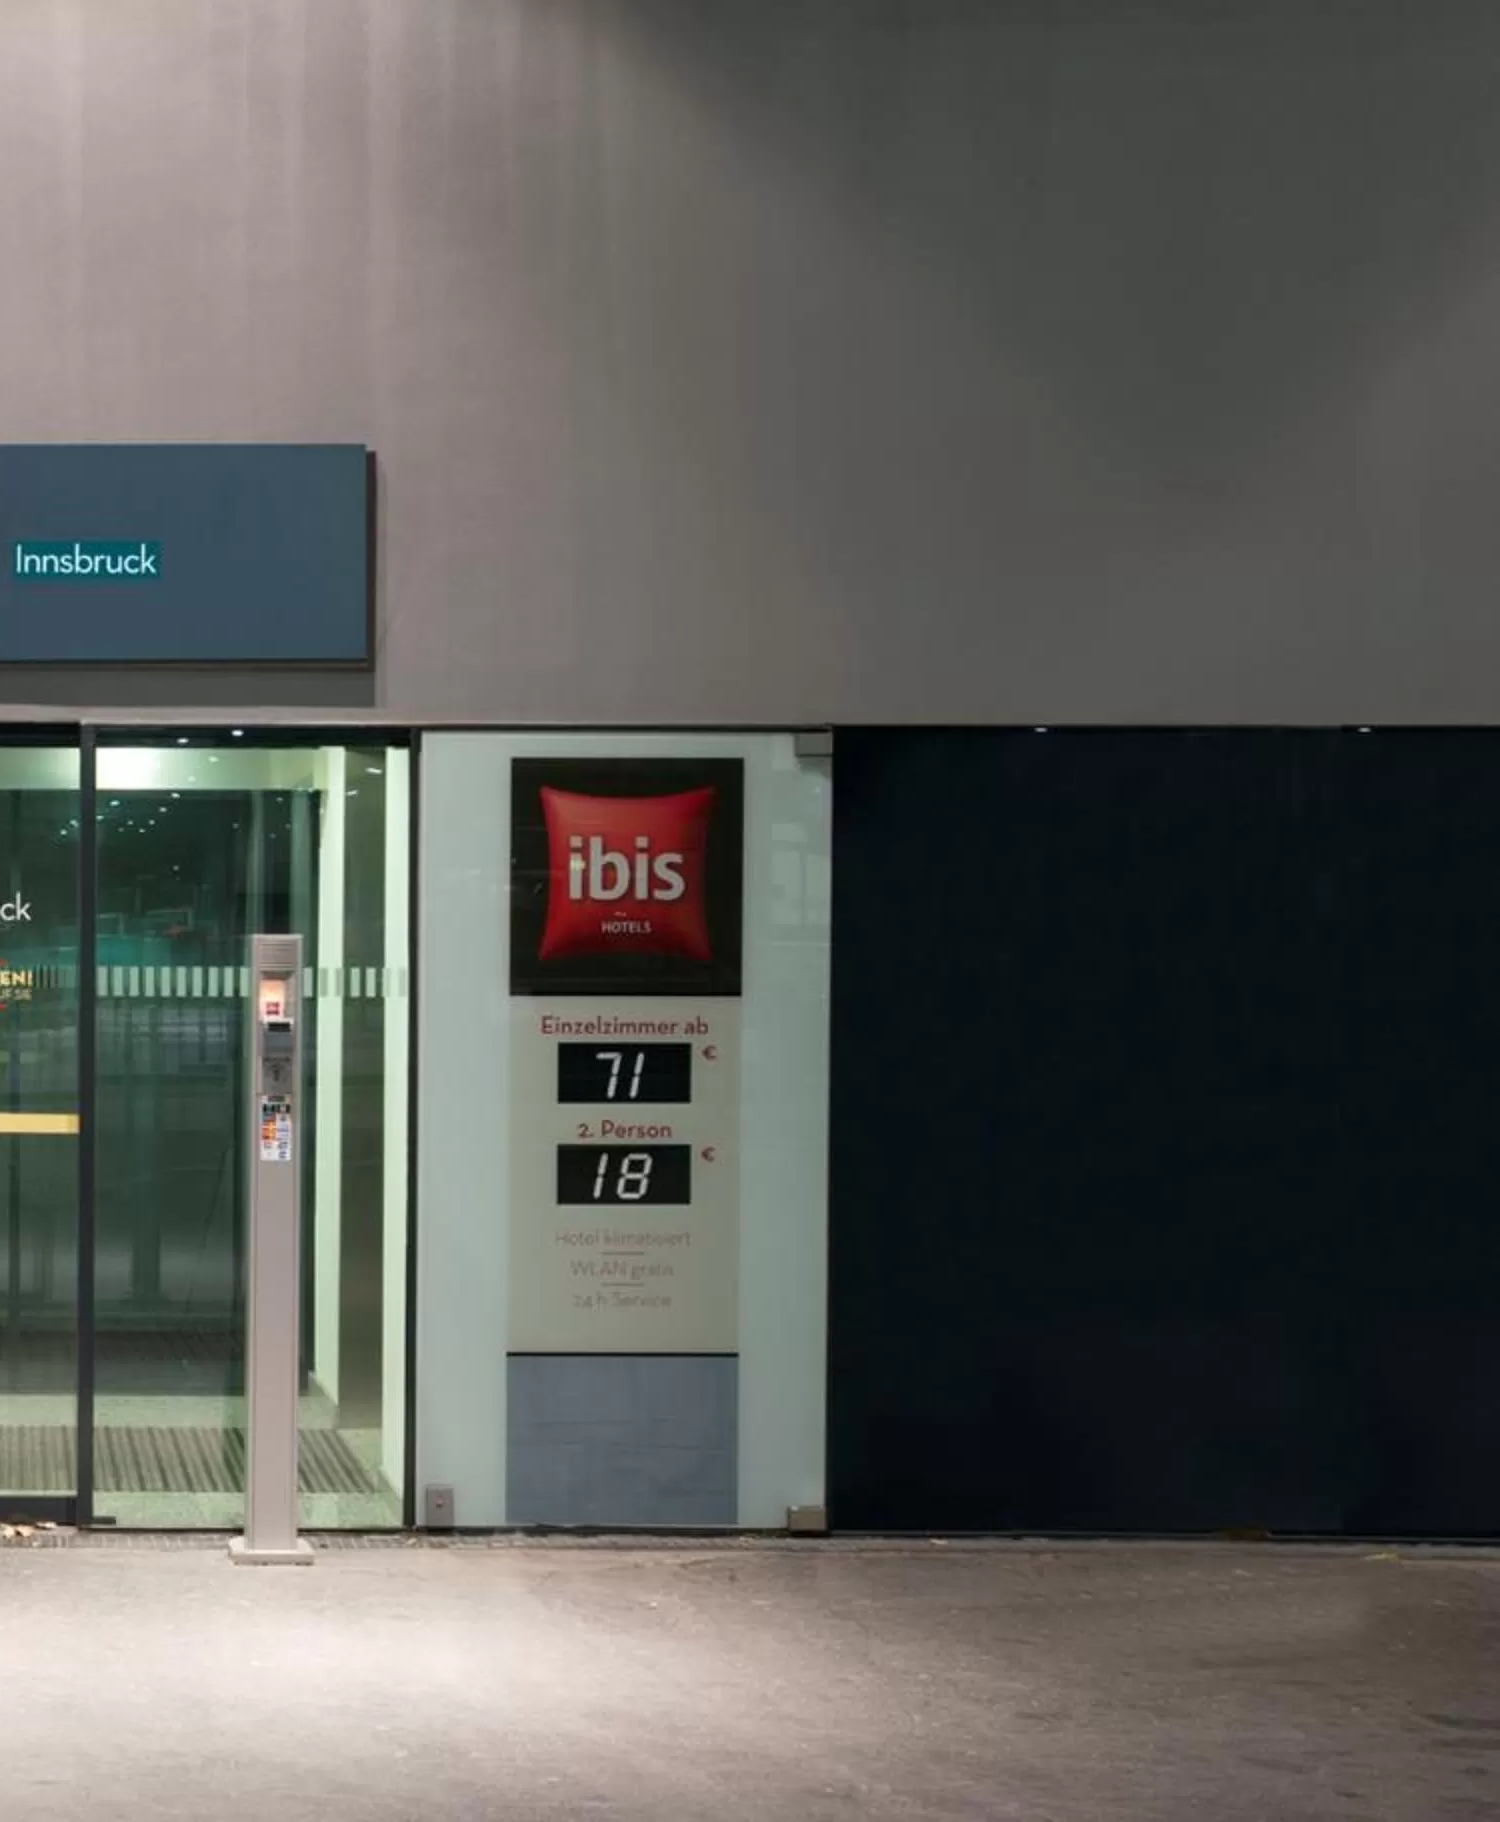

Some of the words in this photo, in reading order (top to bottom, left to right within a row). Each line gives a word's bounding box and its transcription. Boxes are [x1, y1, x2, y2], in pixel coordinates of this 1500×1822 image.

[15, 543, 157, 576] Innsbruck
[568, 835, 686, 901] ibis
[601, 920, 653, 934] HOTELS
[540, 1015, 679, 1035] Einzelzimmer
[683, 1015, 709, 1035] ab
[596, 1051, 645, 1099] 71
[702, 1045, 717, 1061] €
[577, 1123, 594, 1139] 2.
[601, 1119, 673, 1139] Person
[593, 1152, 653, 1200] 18
[701, 1147, 716, 1162] €
[555, 1228, 600, 1246] Hotel
